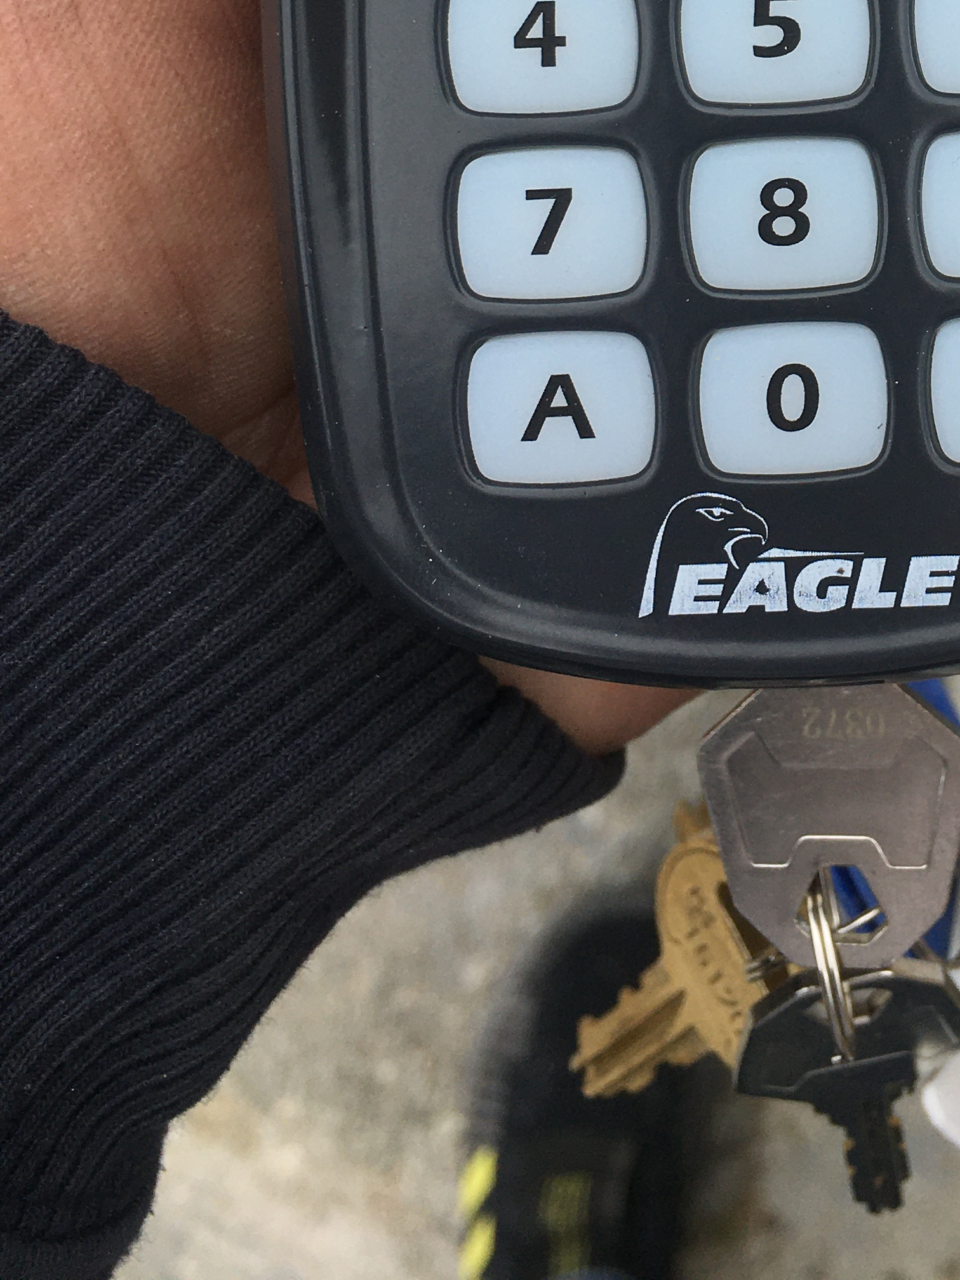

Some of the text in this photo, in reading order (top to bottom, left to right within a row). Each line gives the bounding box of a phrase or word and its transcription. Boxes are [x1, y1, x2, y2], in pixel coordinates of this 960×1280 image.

[513, 0, 567, 68] 4
[525, 187, 573, 256] 7
[757, 177, 811, 247] 8
[520, 373, 597, 442] A
[765, 363, 820, 433] 0
[668, 555, 960, 616] EAGLE
[802, 707, 885, 739] 0372
